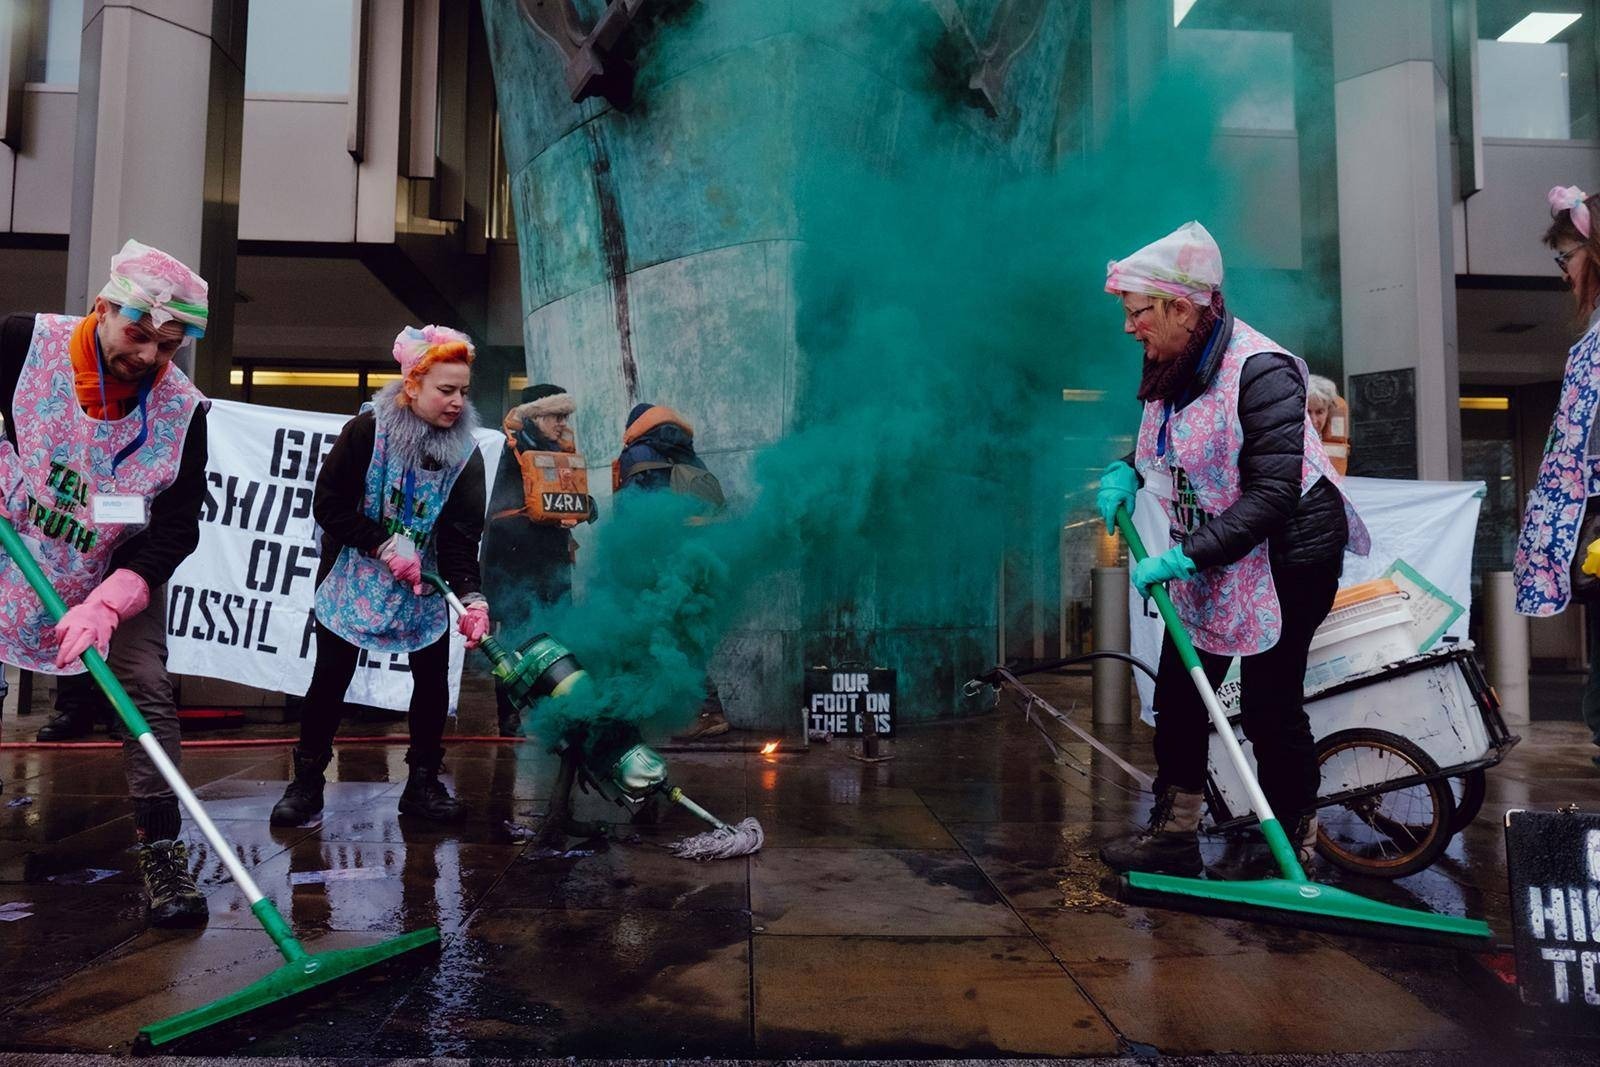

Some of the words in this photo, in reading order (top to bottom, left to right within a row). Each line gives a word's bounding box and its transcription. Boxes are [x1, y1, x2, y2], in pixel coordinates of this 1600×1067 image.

[543, 493, 583, 511] Y4RA
[28, 495, 95, 554] TRUTH
[168, 585, 278, 655] OSSIL
[832, 673, 869, 693] OUR
[812, 693, 859, 713] FOOT
[866, 693, 890, 713] ON
[812, 714, 848, 733] THE
